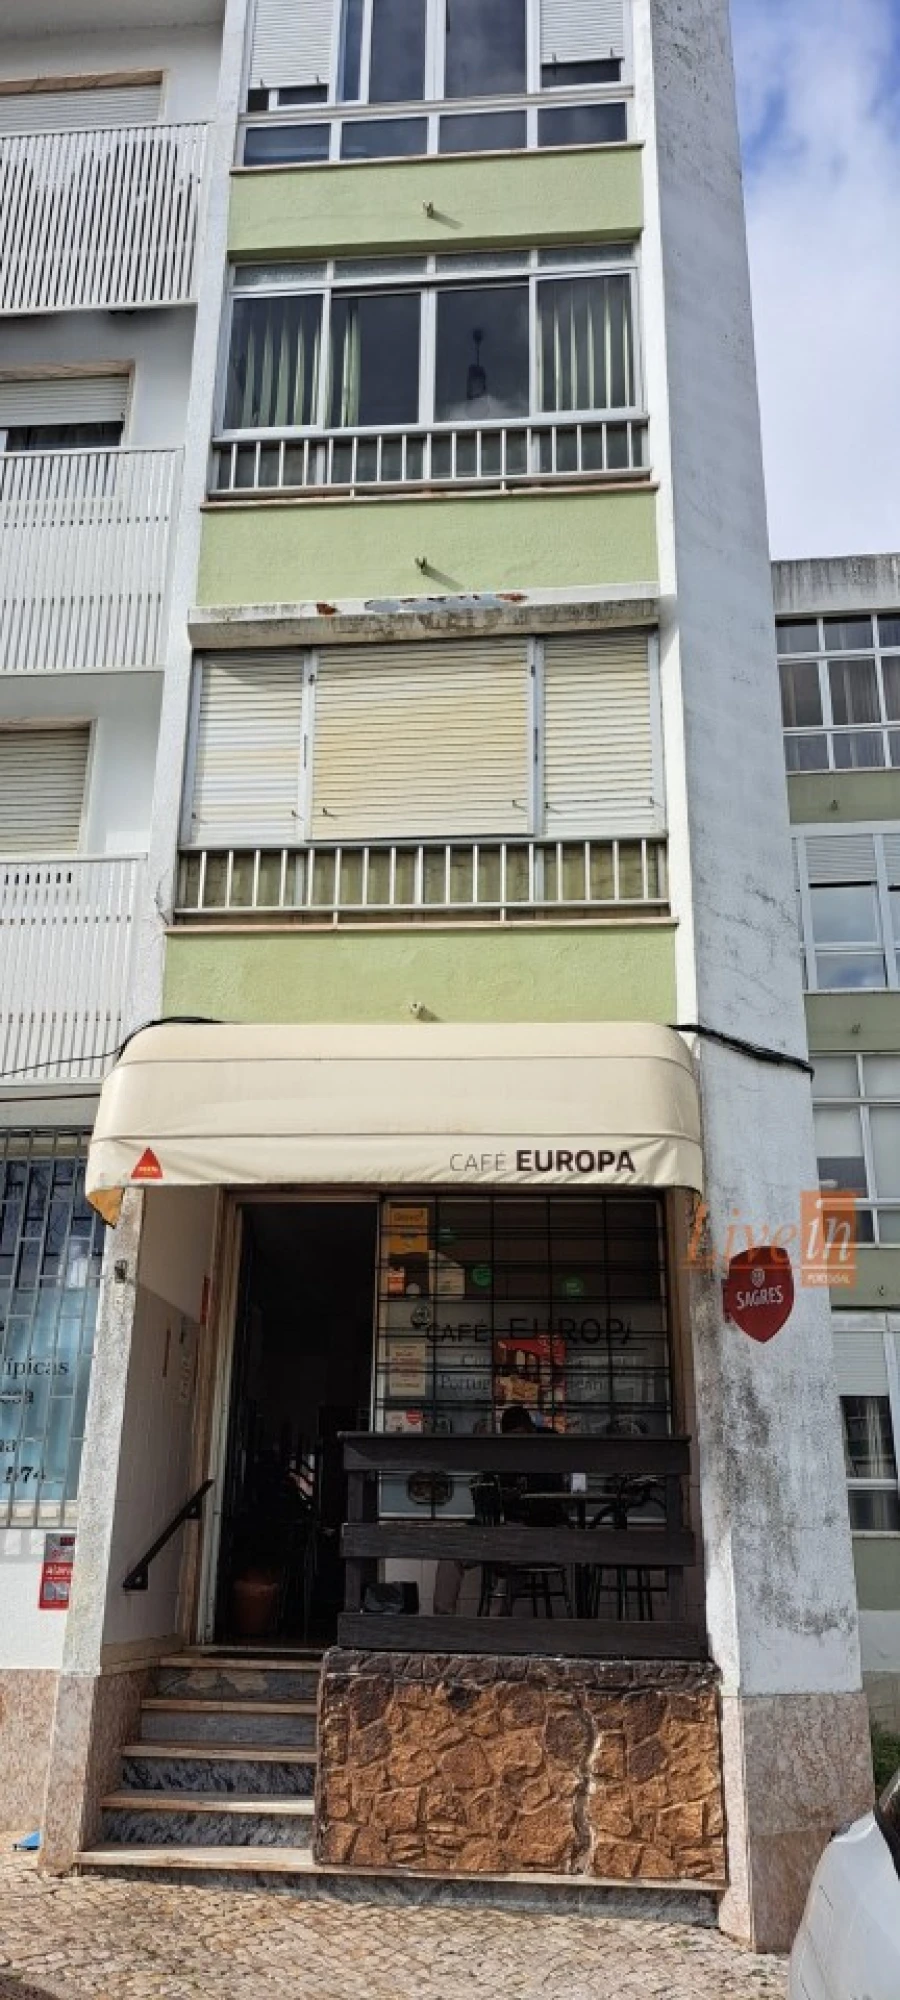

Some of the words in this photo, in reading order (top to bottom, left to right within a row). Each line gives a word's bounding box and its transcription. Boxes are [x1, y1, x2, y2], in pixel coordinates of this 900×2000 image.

[450, 1151, 507, 1172] CAFÉ
[516, 1149, 636, 1173] EUROPA
[735, 1284, 784, 1310] SAGRES
[3, 1355, 69, 1380] ípicas
